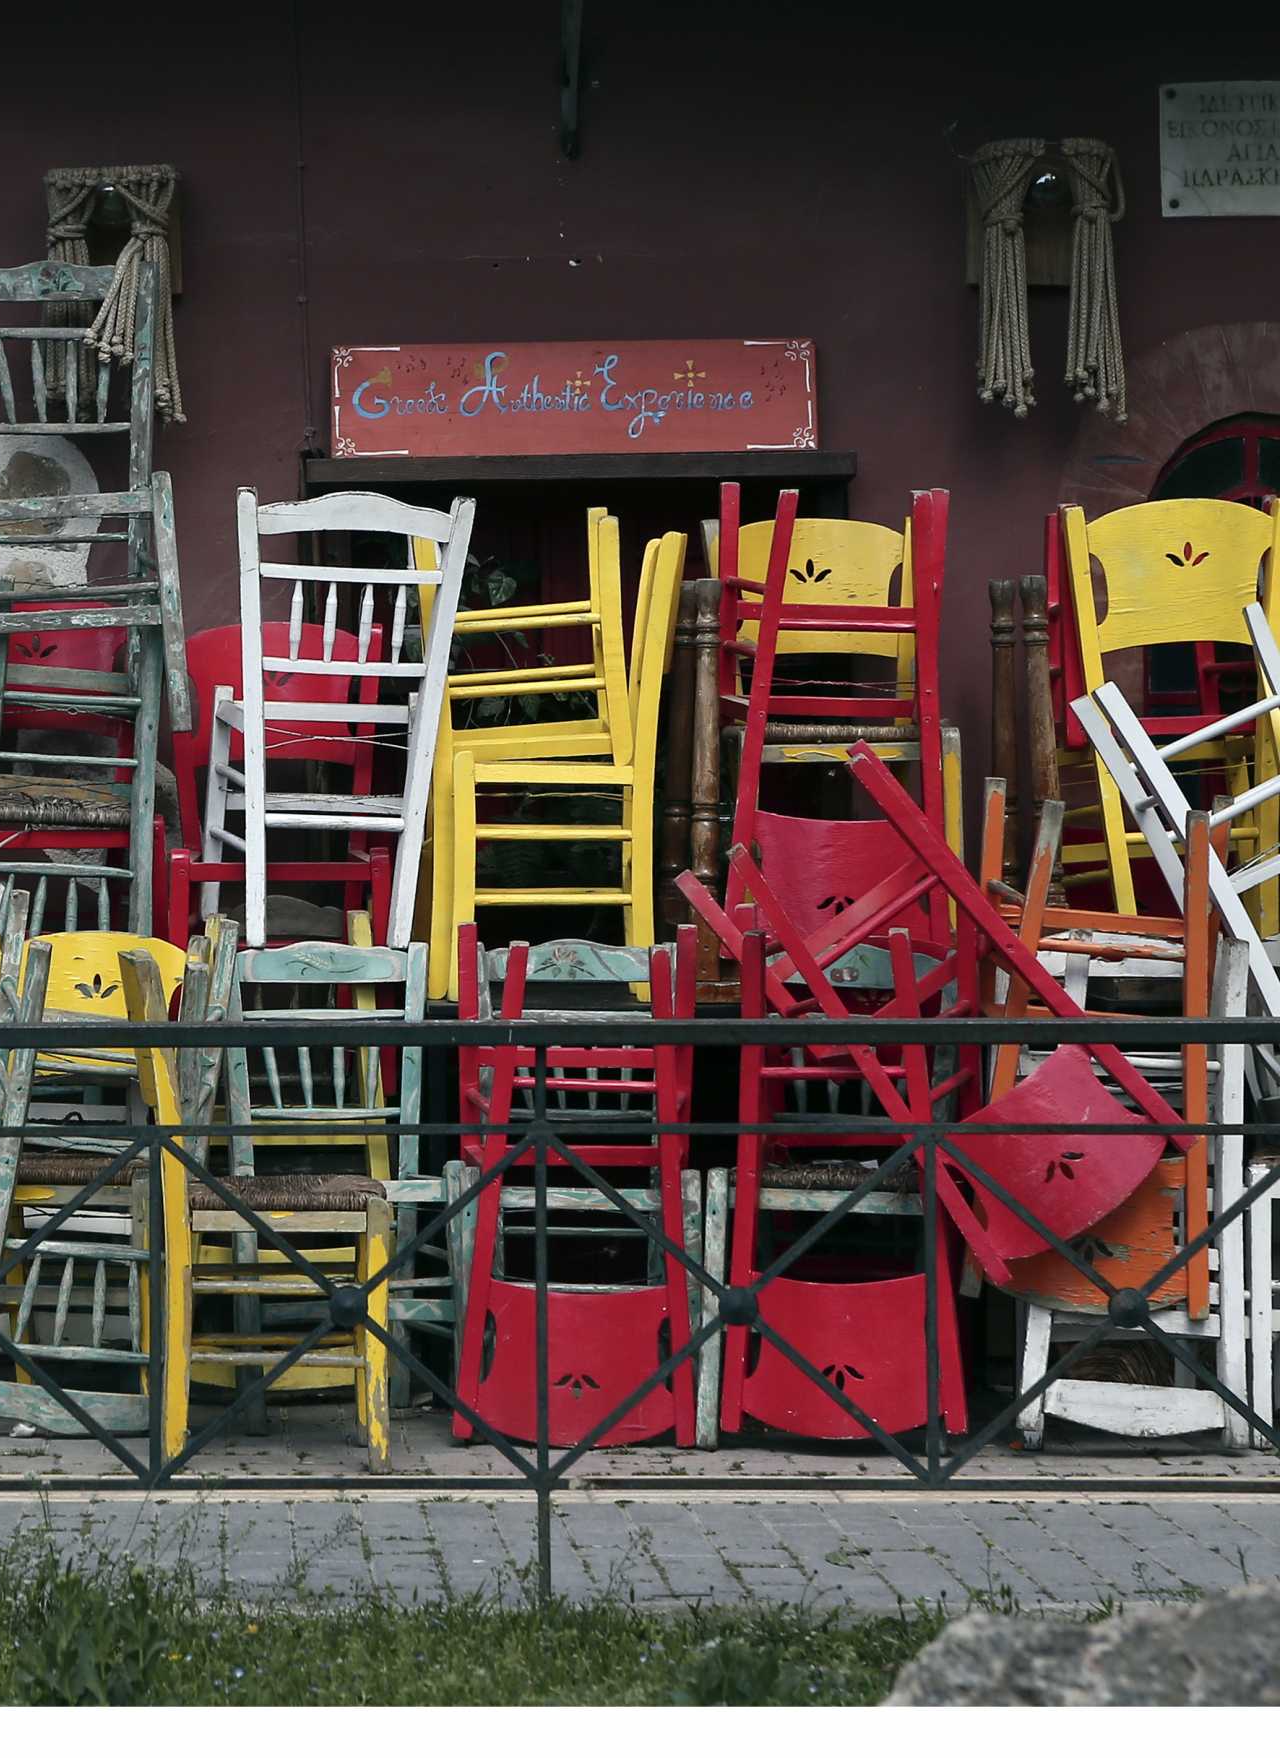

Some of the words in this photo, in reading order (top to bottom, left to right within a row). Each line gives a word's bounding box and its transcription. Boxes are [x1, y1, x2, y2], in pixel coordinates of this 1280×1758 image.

[352, 378, 448, 420] Greek
[459, 351, 591, 417] Authentic
[593, 354, 753, 438] Experience
